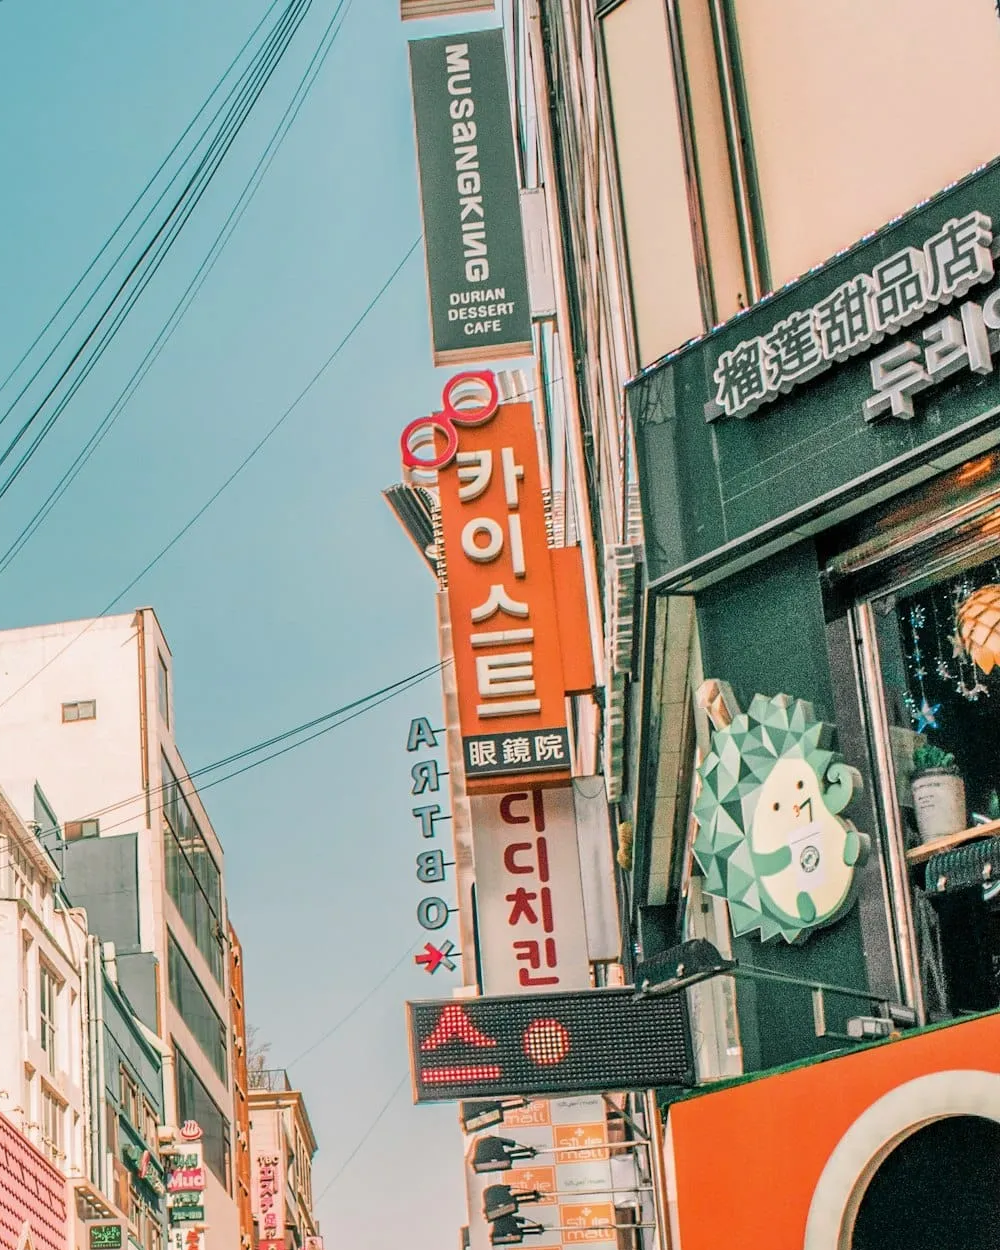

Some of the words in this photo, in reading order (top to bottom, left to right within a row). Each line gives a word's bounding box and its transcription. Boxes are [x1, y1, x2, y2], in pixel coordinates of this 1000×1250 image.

[450, 288, 505, 306] DURIAN
[448, 302, 515, 321] DESSERT
[464, 320, 502, 336] CAFE
[456, 447, 541, 719] 카이스트
[468, 733, 563, 768] 眼鏡院
[500, 789, 560, 988] 디디치킨
[168, 1173, 204, 1188] Mud
